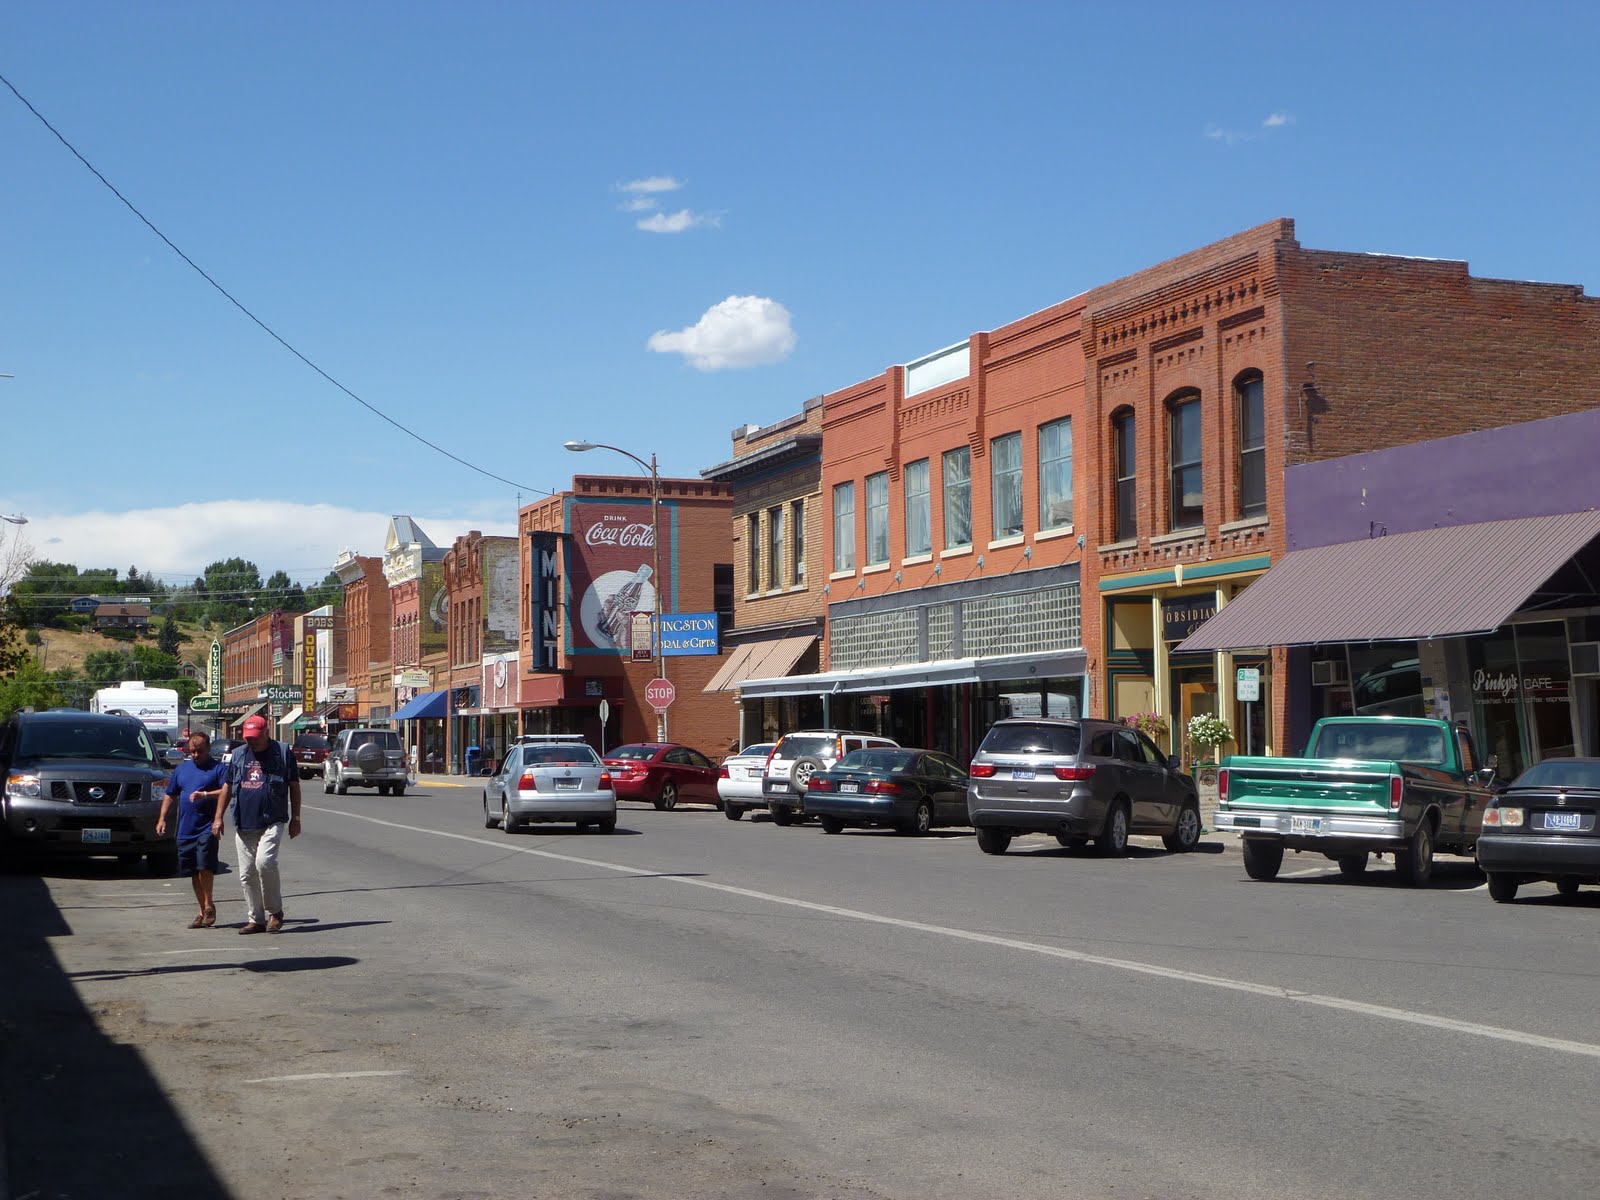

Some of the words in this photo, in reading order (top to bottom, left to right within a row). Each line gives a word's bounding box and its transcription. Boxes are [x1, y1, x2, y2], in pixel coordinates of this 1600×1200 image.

[585, 522, 655, 547] Coca-Cola
[541, 551, 558, 668] MINT
[1166, 608, 1216, 623] OBSIDIAN
[307, 617, 334, 628] BOB'S
[653, 619, 715, 632] IINGSTON
[305, 634, 315, 712] OUTDOOR
[1239, 671, 1245, 680] 2
[1473, 669, 1518, 696] Pinky's
[1524, 678, 1552, 690] CAFE
[268, 687, 302, 699] Stockm
[647, 687, 673, 699] STOP
[1525, 696, 1543, 704] coffee
